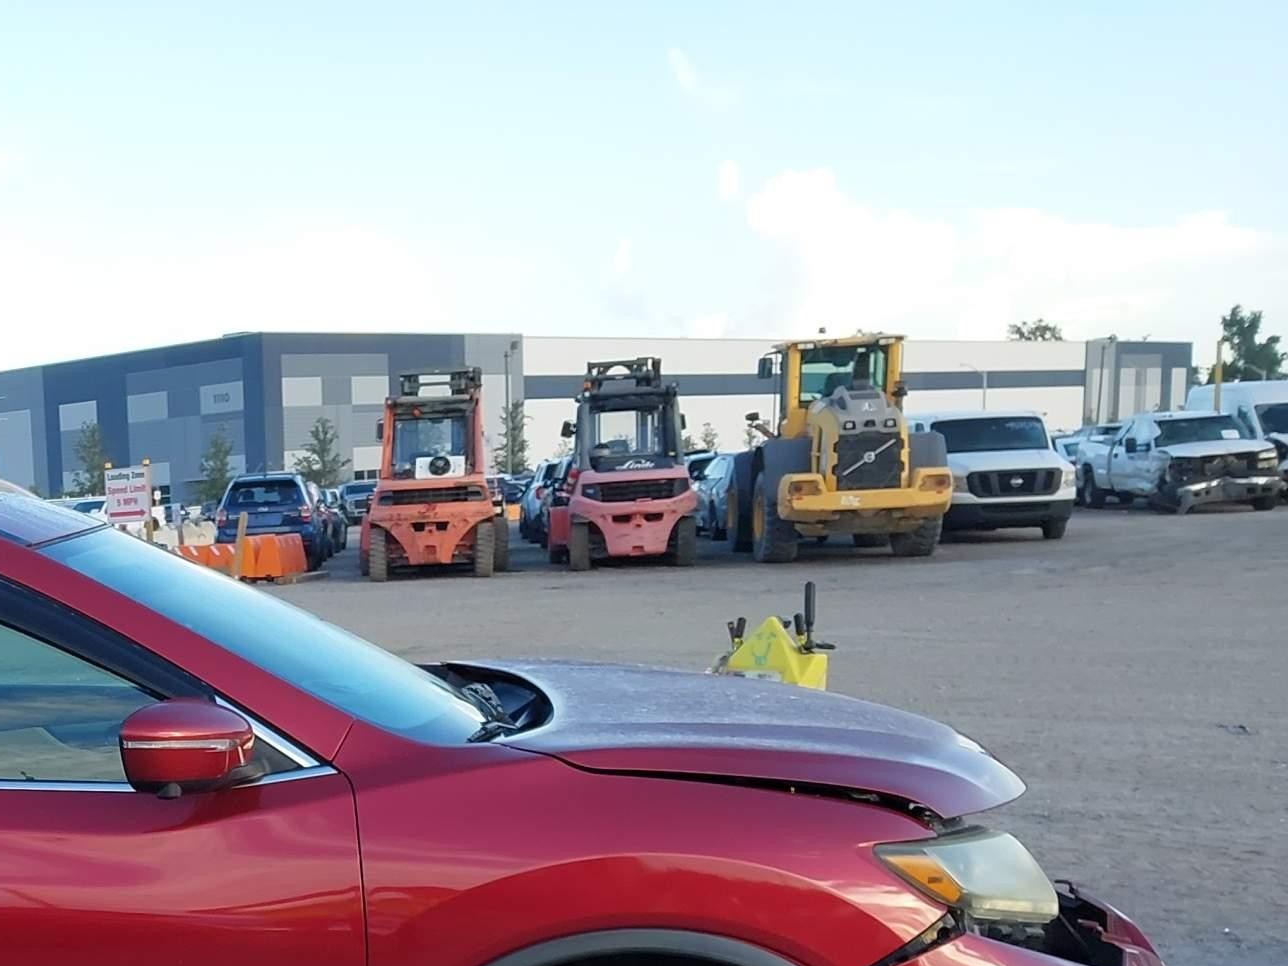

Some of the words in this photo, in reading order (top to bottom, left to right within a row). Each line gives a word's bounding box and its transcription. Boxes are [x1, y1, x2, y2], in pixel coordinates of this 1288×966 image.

[615, 458, 655, 470] Linde
[107, 473, 130, 481] Loading
[108, 486, 128, 494] Speed
[129, 485, 146, 493] Limit
